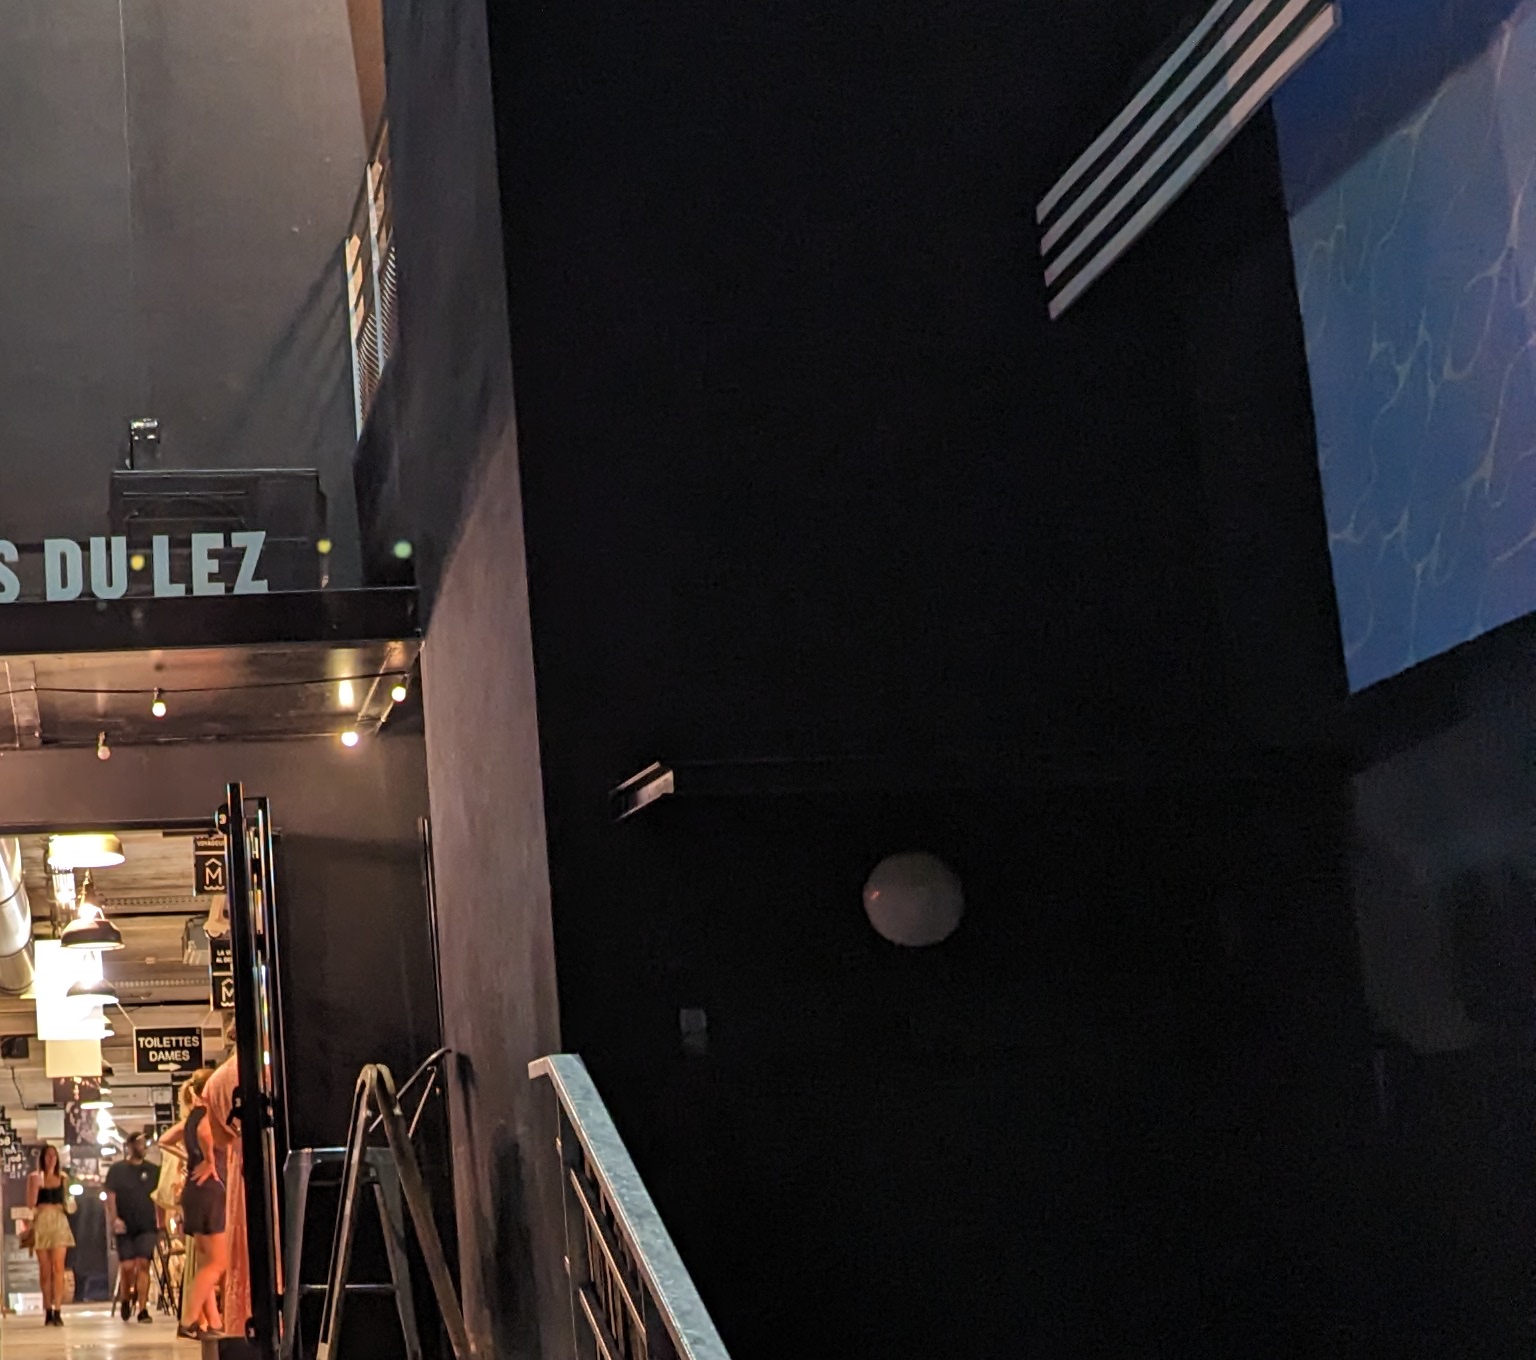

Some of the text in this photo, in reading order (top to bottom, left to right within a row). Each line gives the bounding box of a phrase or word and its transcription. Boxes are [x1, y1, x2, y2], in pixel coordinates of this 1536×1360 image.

[43, 535, 129, 601] DU
[151, 530, 270, 597] LEZ
[138, 1035, 200, 1051] TOILETTES
[149, 1050, 190, 1064] DAMES
